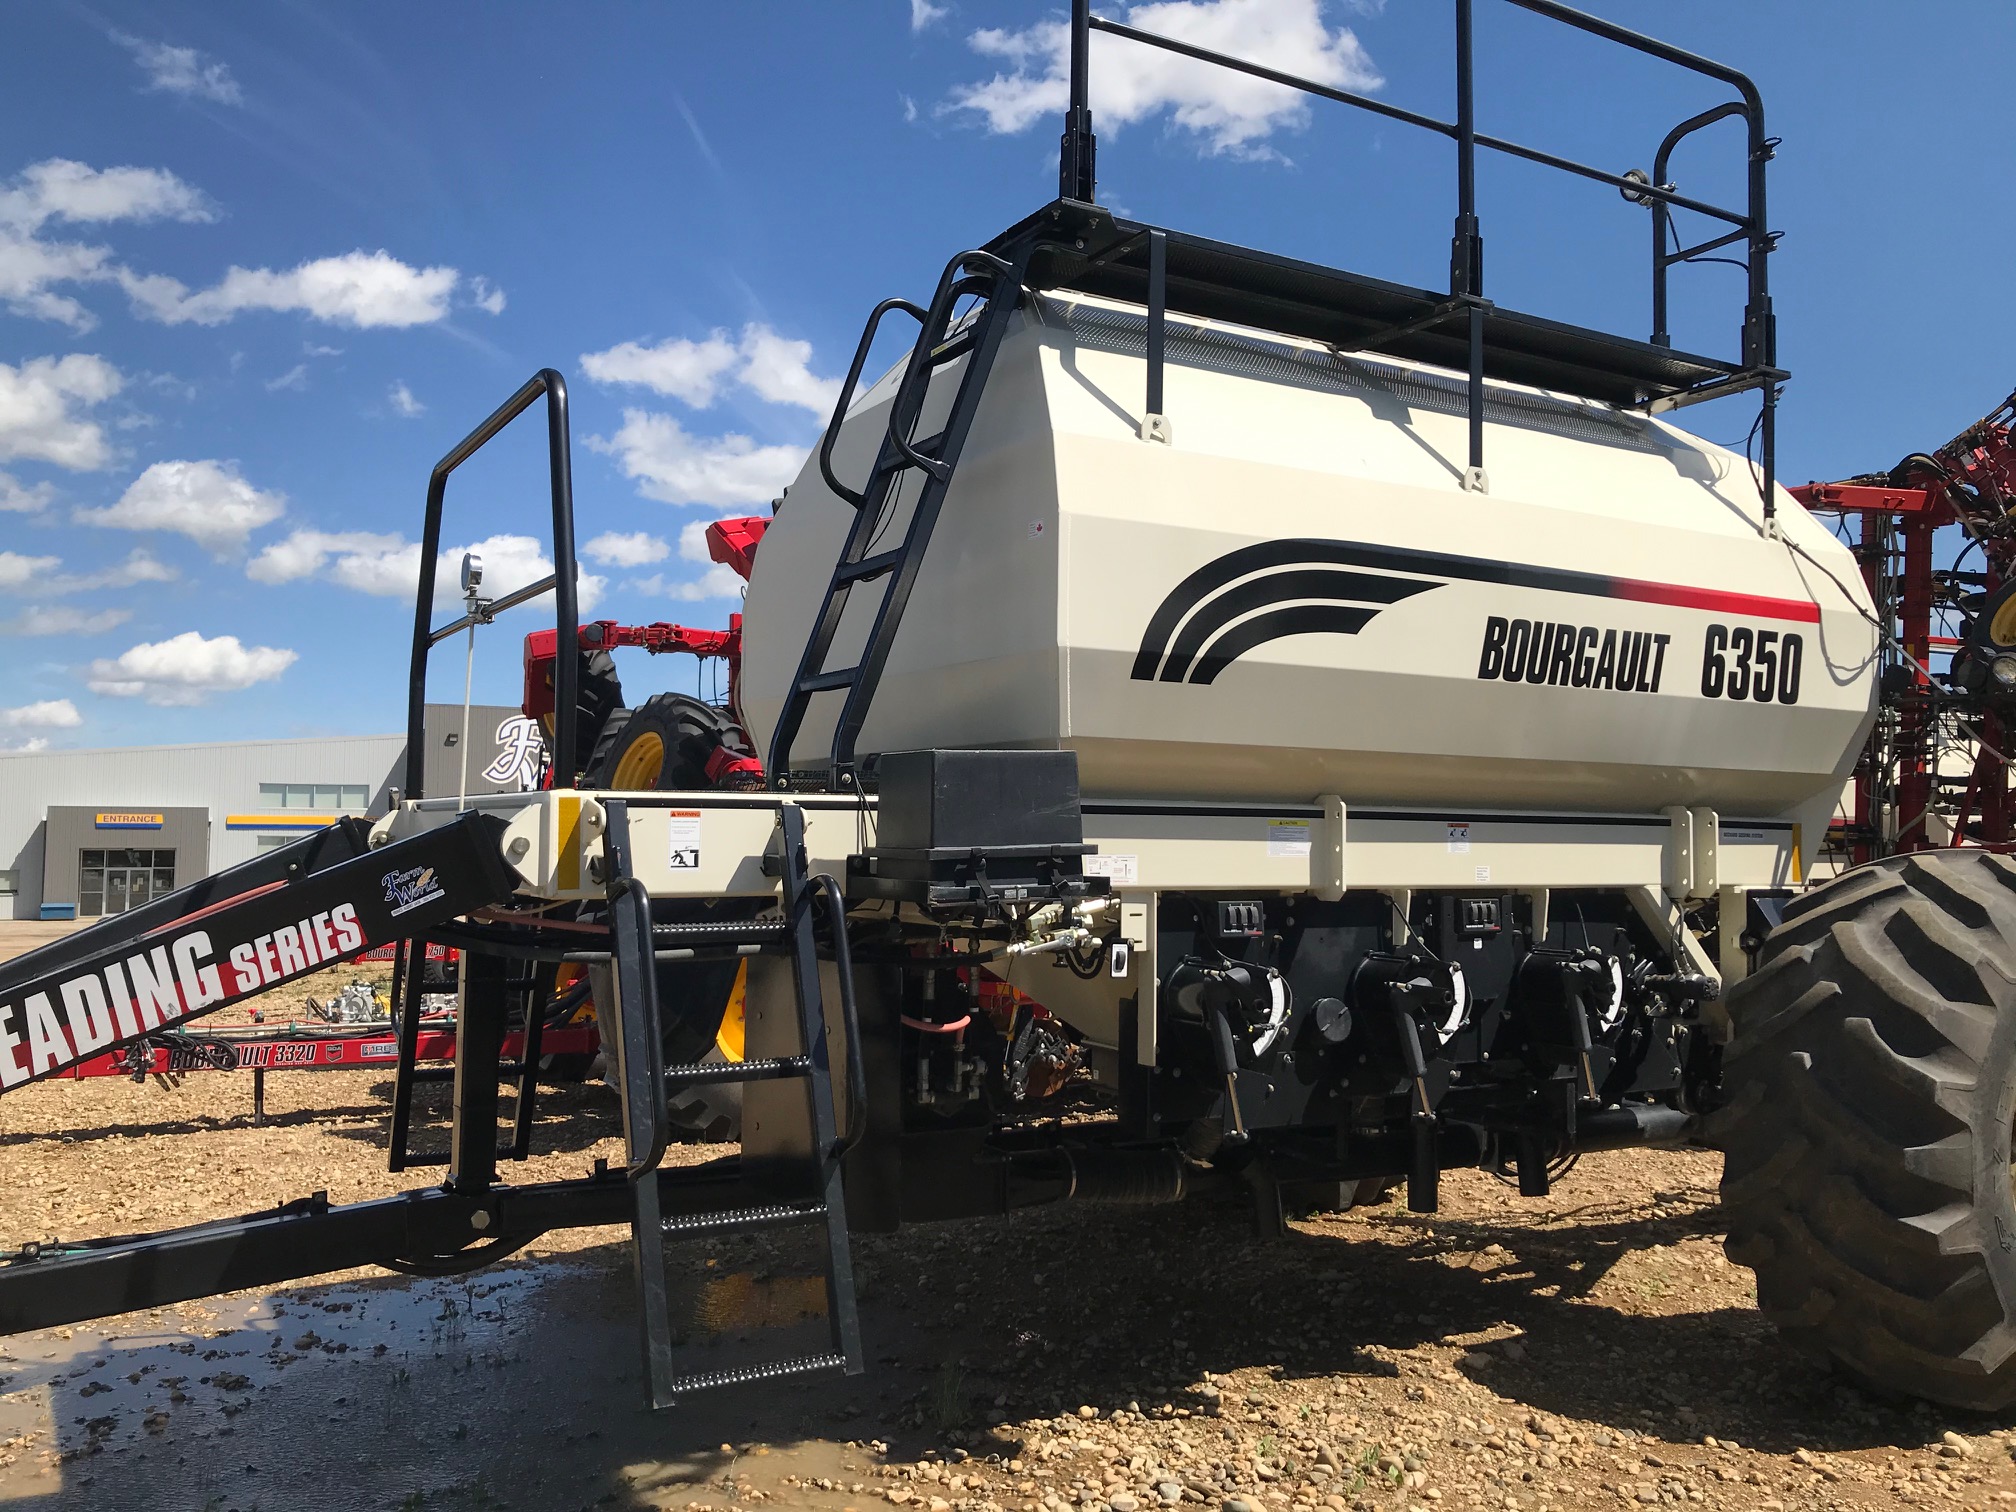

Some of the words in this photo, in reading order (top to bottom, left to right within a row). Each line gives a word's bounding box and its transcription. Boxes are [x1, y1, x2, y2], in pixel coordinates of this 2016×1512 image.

[1477, 615, 1671, 693] BOURGAULT
[1699, 623, 1804, 705] 6350
[103, 815, 157, 823] ENTRANCE
[229, 902, 363, 993] SERIES
[274, 1043, 318, 1063] 3320
